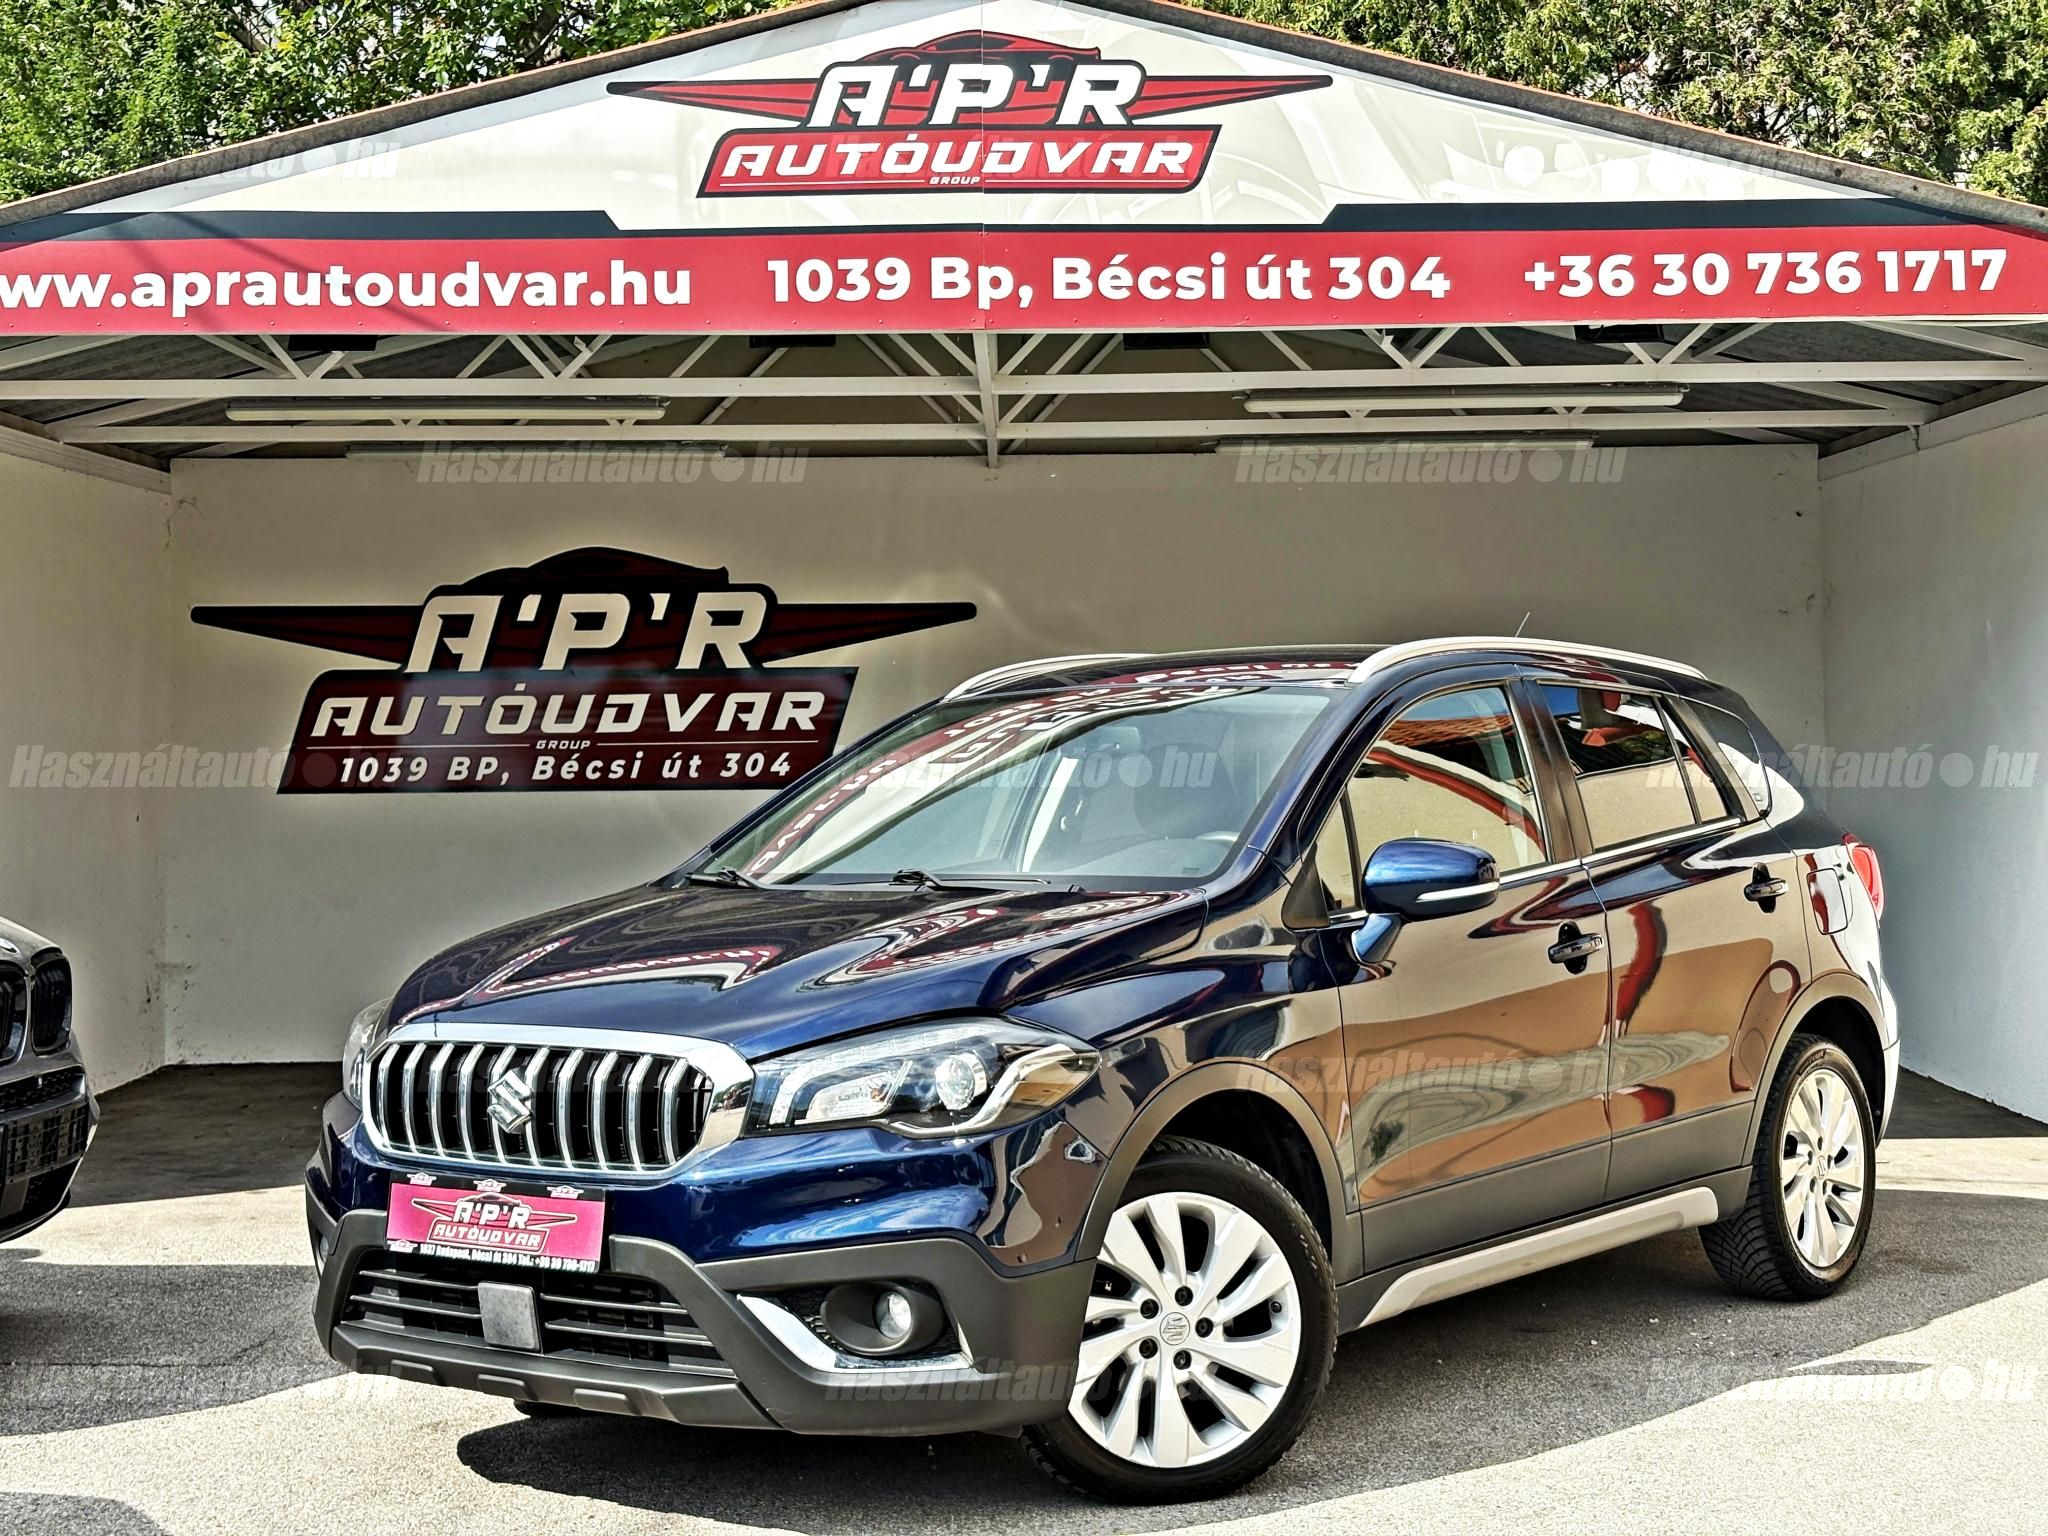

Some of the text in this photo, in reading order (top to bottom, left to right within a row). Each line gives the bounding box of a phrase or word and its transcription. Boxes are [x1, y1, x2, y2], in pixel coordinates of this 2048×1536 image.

[721, 133, 1193, 177] AUTÓUDVAR
[929, 176, 982, 186] GROUP
[769, 252, 1451, 309] 1039 Bp, Bécsi út 304
[1525, 249, 2008, 299] +36 30 736 1717
[311, 682, 826, 736] AUTÓUDVAR
[536, 739, 591, 751] GROUP
[340, 750, 792, 785] 1039 BP, Bécsi út 304
